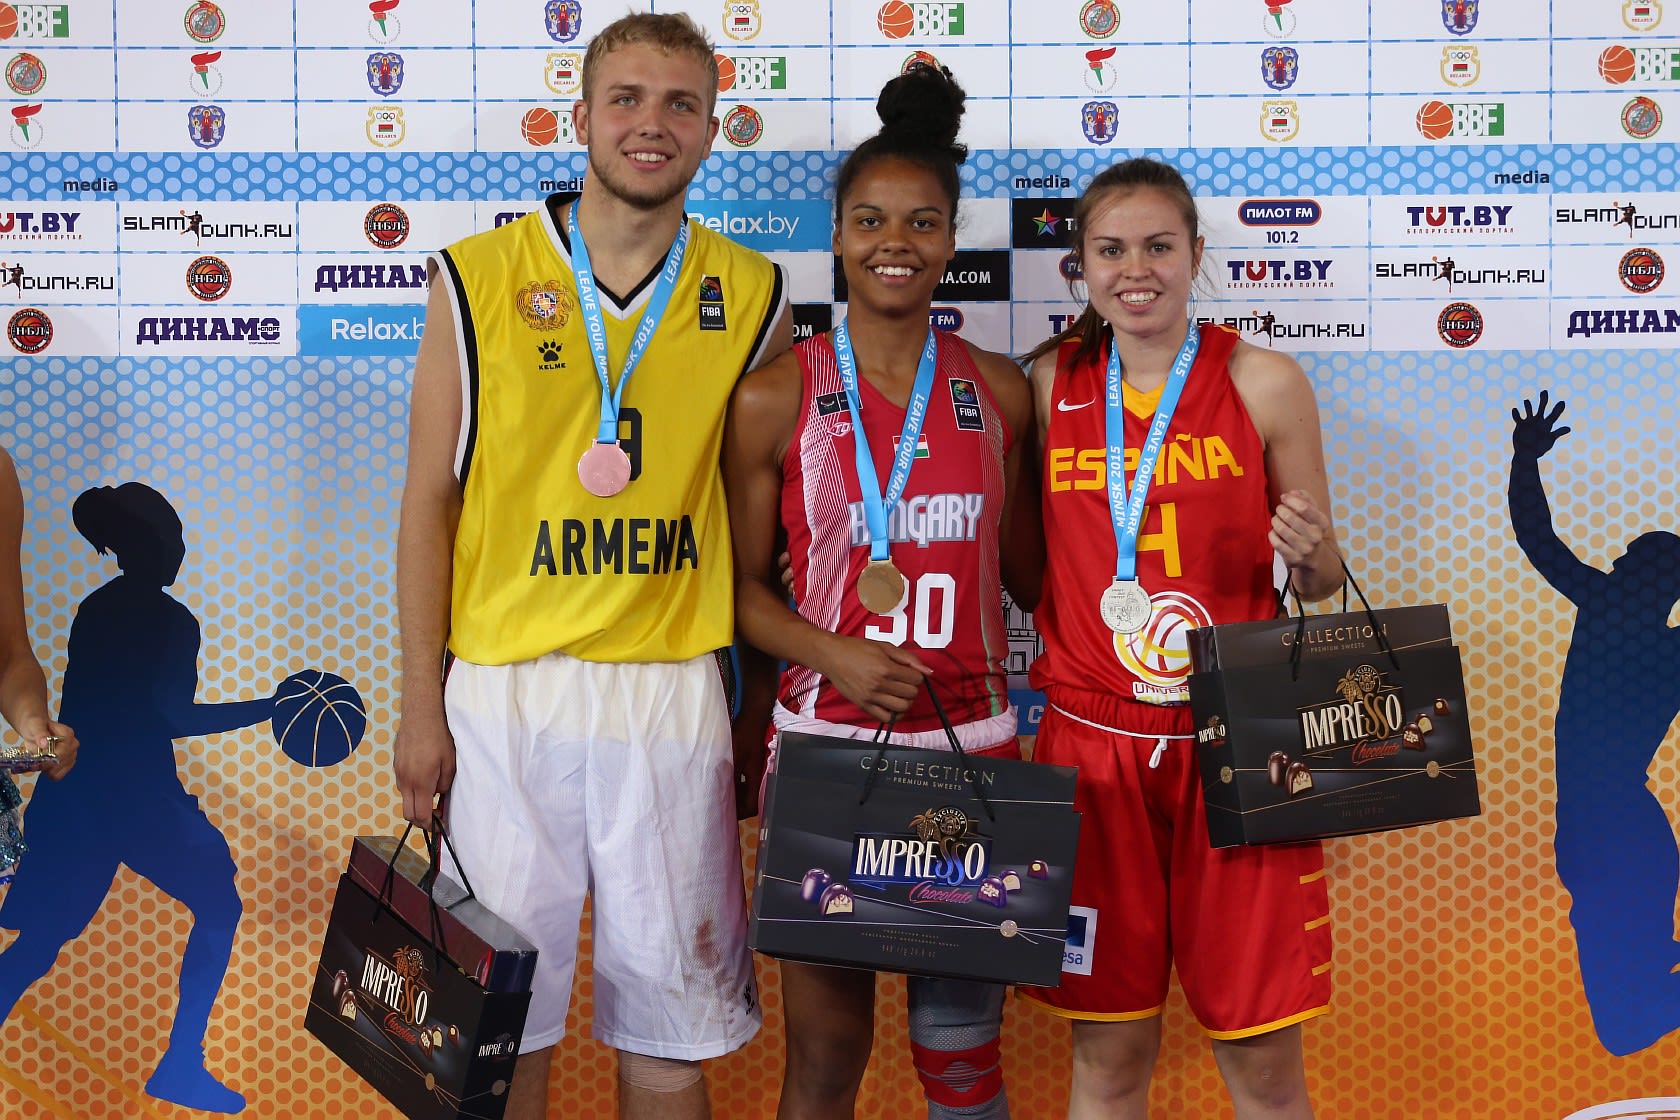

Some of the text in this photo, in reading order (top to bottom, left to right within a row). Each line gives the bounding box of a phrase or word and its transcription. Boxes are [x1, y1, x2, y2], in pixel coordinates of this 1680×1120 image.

[18, 5, 62, 38] BBF
[914, 4, 958, 35] BBF
[736, 57, 780, 89] BBF
[1636, 48, 1680, 80] BBF
[1453, 104, 1497, 136] BBF
[63, 178, 118, 191] media
[540, 178, 584, 191] medi
[1015, 175, 1070, 188] media
[1494, 170, 1550, 184] media
[1246, 208, 1313, 218] ПИЛОТ FM
[1407, 206, 1513, 227] TUT.BY
[1556, 209, 1618, 223] SLAM
[124, 216, 292, 238] SLAM DUNK.RU
[373, 222, 400, 231] НБЛ
[1266, 231, 1299, 243] 101.2
[665, 243, 684, 284] LEAVE
[1227, 260, 1333, 281] TUT.BY
[1376, 263, 1545, 283] SLAM DUNK.RU
[1627, 266, 1656, 275] НБЛ
[23, 276, 114, 290] DUNK.RU
[195, 275, 222, 283] НБЛ
[314, 265, 427, 293] ДИНАМ
[577, 270, 595, 311] LEAVE
[588, 314, 605, 351] YOUR
[702, 307, 721, 317] FIBA
[17, 327, 44, 336] НБЛ
[331, 317, 425, 340] Relax.b
[634, 315, 655, 351] 2015
[1274, 324, 1365, 338] DUNK.RU
[1446, 321, 1475, 330] НБЛ
[539, 362, 567, 370] KELME
[840, 353, 854, 390] LEAVE
[1175, 345, 1195, 377] 2015
[1109, 368, 1119, 407] LEAVE
[907, 393, 925, 434] LEAVE
[959, 407, 978, 418] FIBA
[899, 434, 915, 469] YOUR
[1127, 412, 1168, 536] LEAVE YOUR MARK
[1110, 446, 1126, 528] MINSK 2015
[848, 493, 983, 548] HNGARY
[530, 514, 698, 577] ARMENA
[1135, 502, 1182, 578] 4
[865, 573, 956, 648] 30
[1301, 693, 1402, 750] IMPRESSO
[1352, 740, 1401, 765] Chocolate
[860, 756, 995, 786] COLLECTION
[893, 777, 962, 791] PREMIUM SWEETS
[855, 836, 985, 887] IMPRESSO
[909, 881, 974, 905] Chocolate
[361, 954, 428, 1025] IMPRESSO
